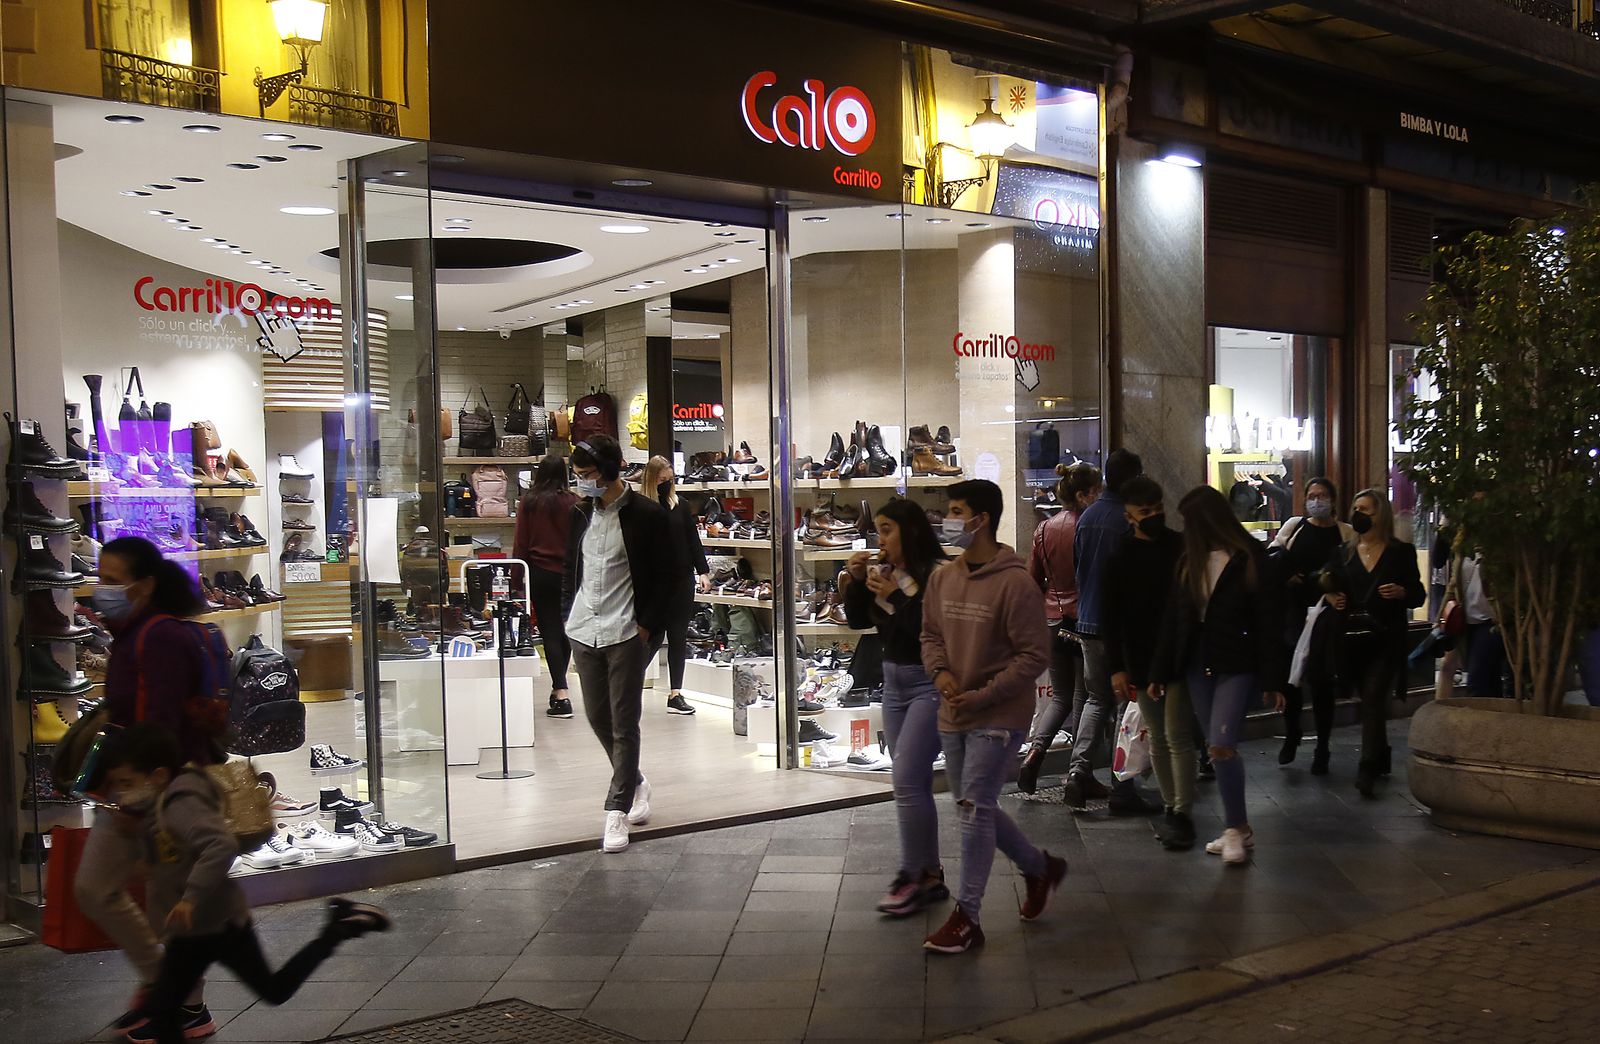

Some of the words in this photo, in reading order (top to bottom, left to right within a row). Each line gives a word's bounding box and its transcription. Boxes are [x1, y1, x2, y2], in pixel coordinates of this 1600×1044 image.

[1400, 112, 1433, 135] BIMBA
[1434, 120, 1442, 136] Y
[1443, 123, 1469, 143] LOLA
[138, 316, 165, 331] Sólo
[169, 321, 186, 331] un
[188, 319, 218, 332] click
